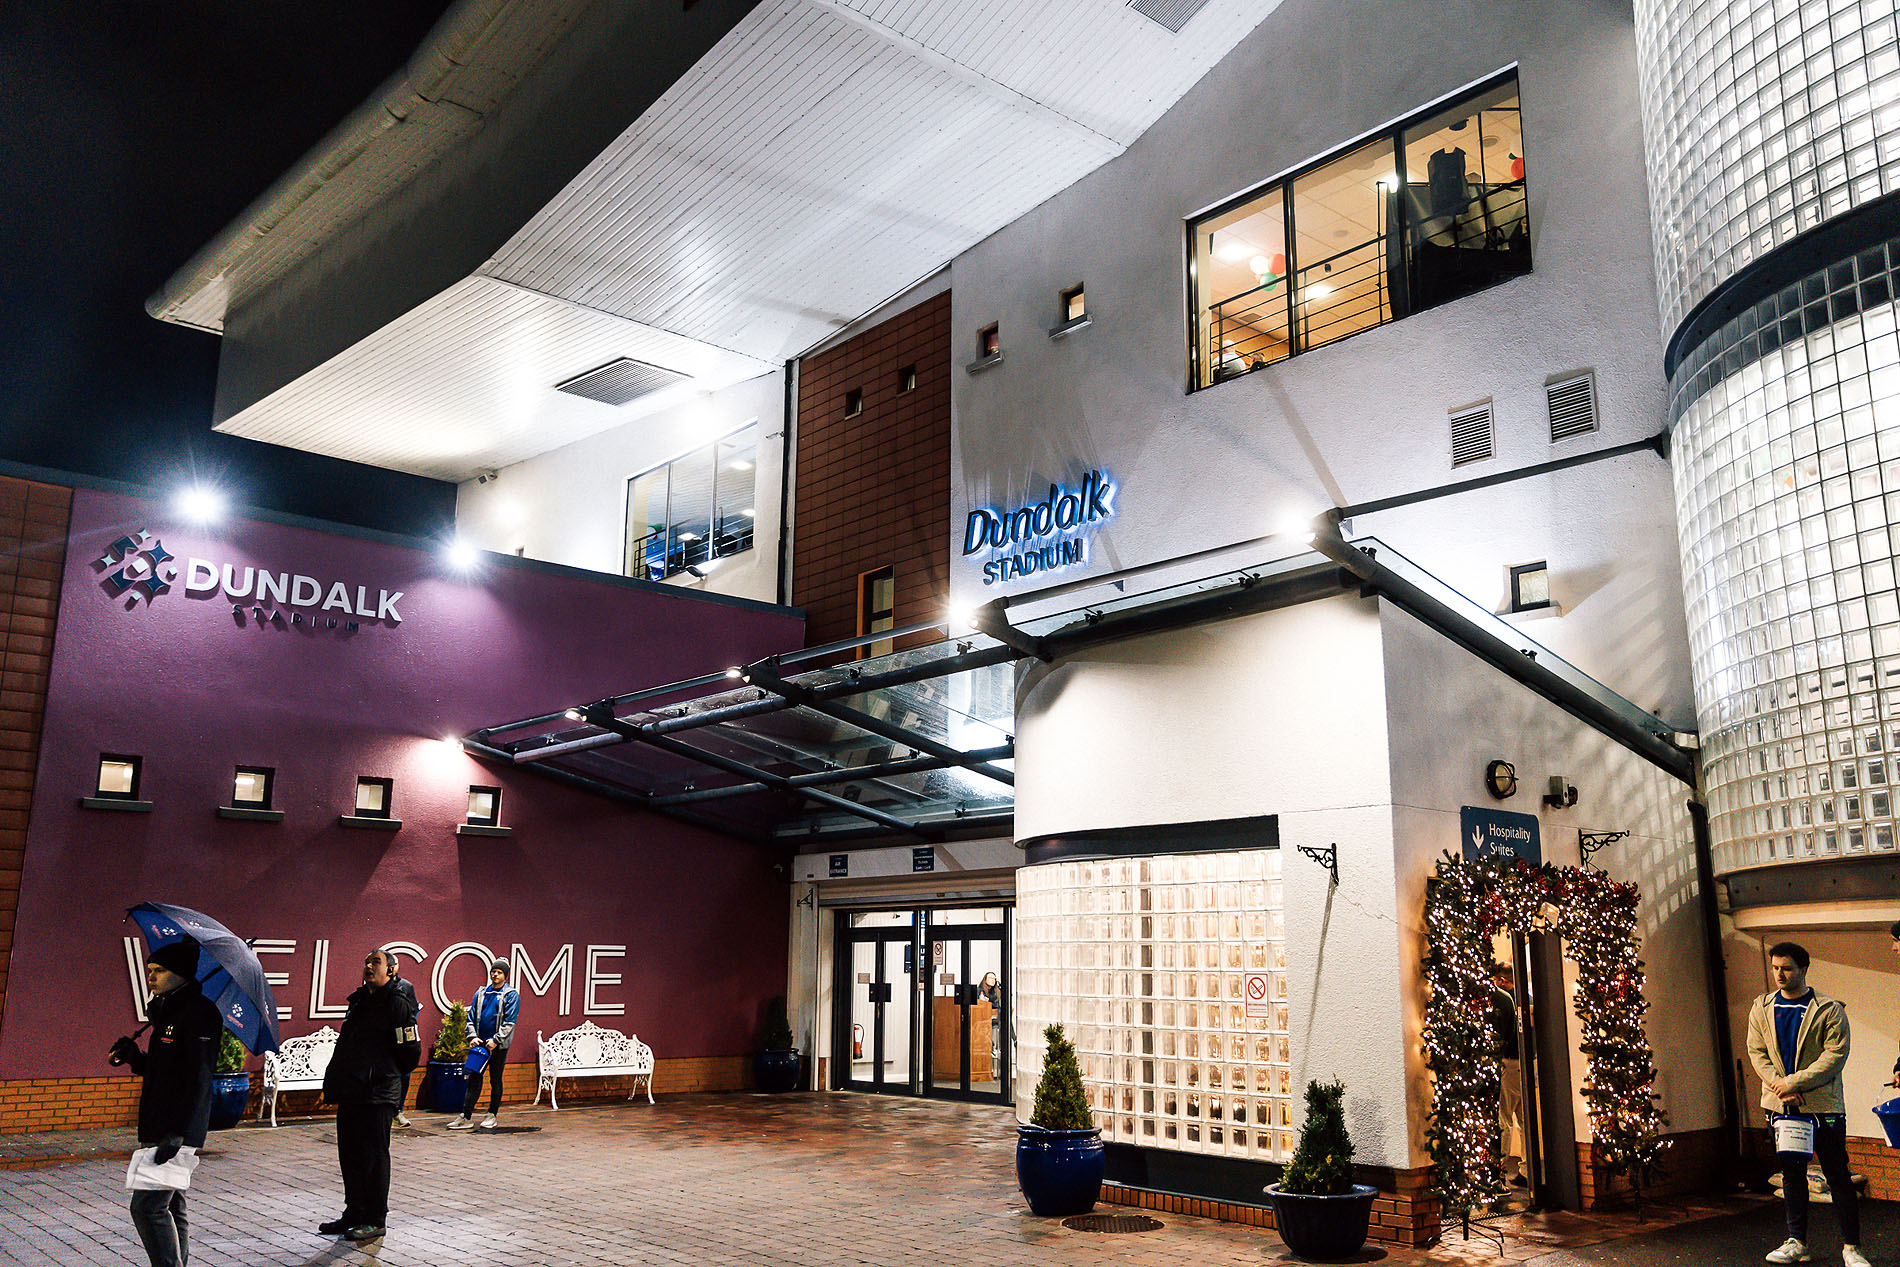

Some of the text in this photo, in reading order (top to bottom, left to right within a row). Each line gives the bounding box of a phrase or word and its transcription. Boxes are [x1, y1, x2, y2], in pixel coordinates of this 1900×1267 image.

[963, 469, 1111, 556] Dundalk
[983, 538, 1083, 585] STADIUM
[185, 557, 404, 622] DUNDALK
[232, 604, 360, 633] STADIUM
[1489, 823, 1531, 843] Hospitality
